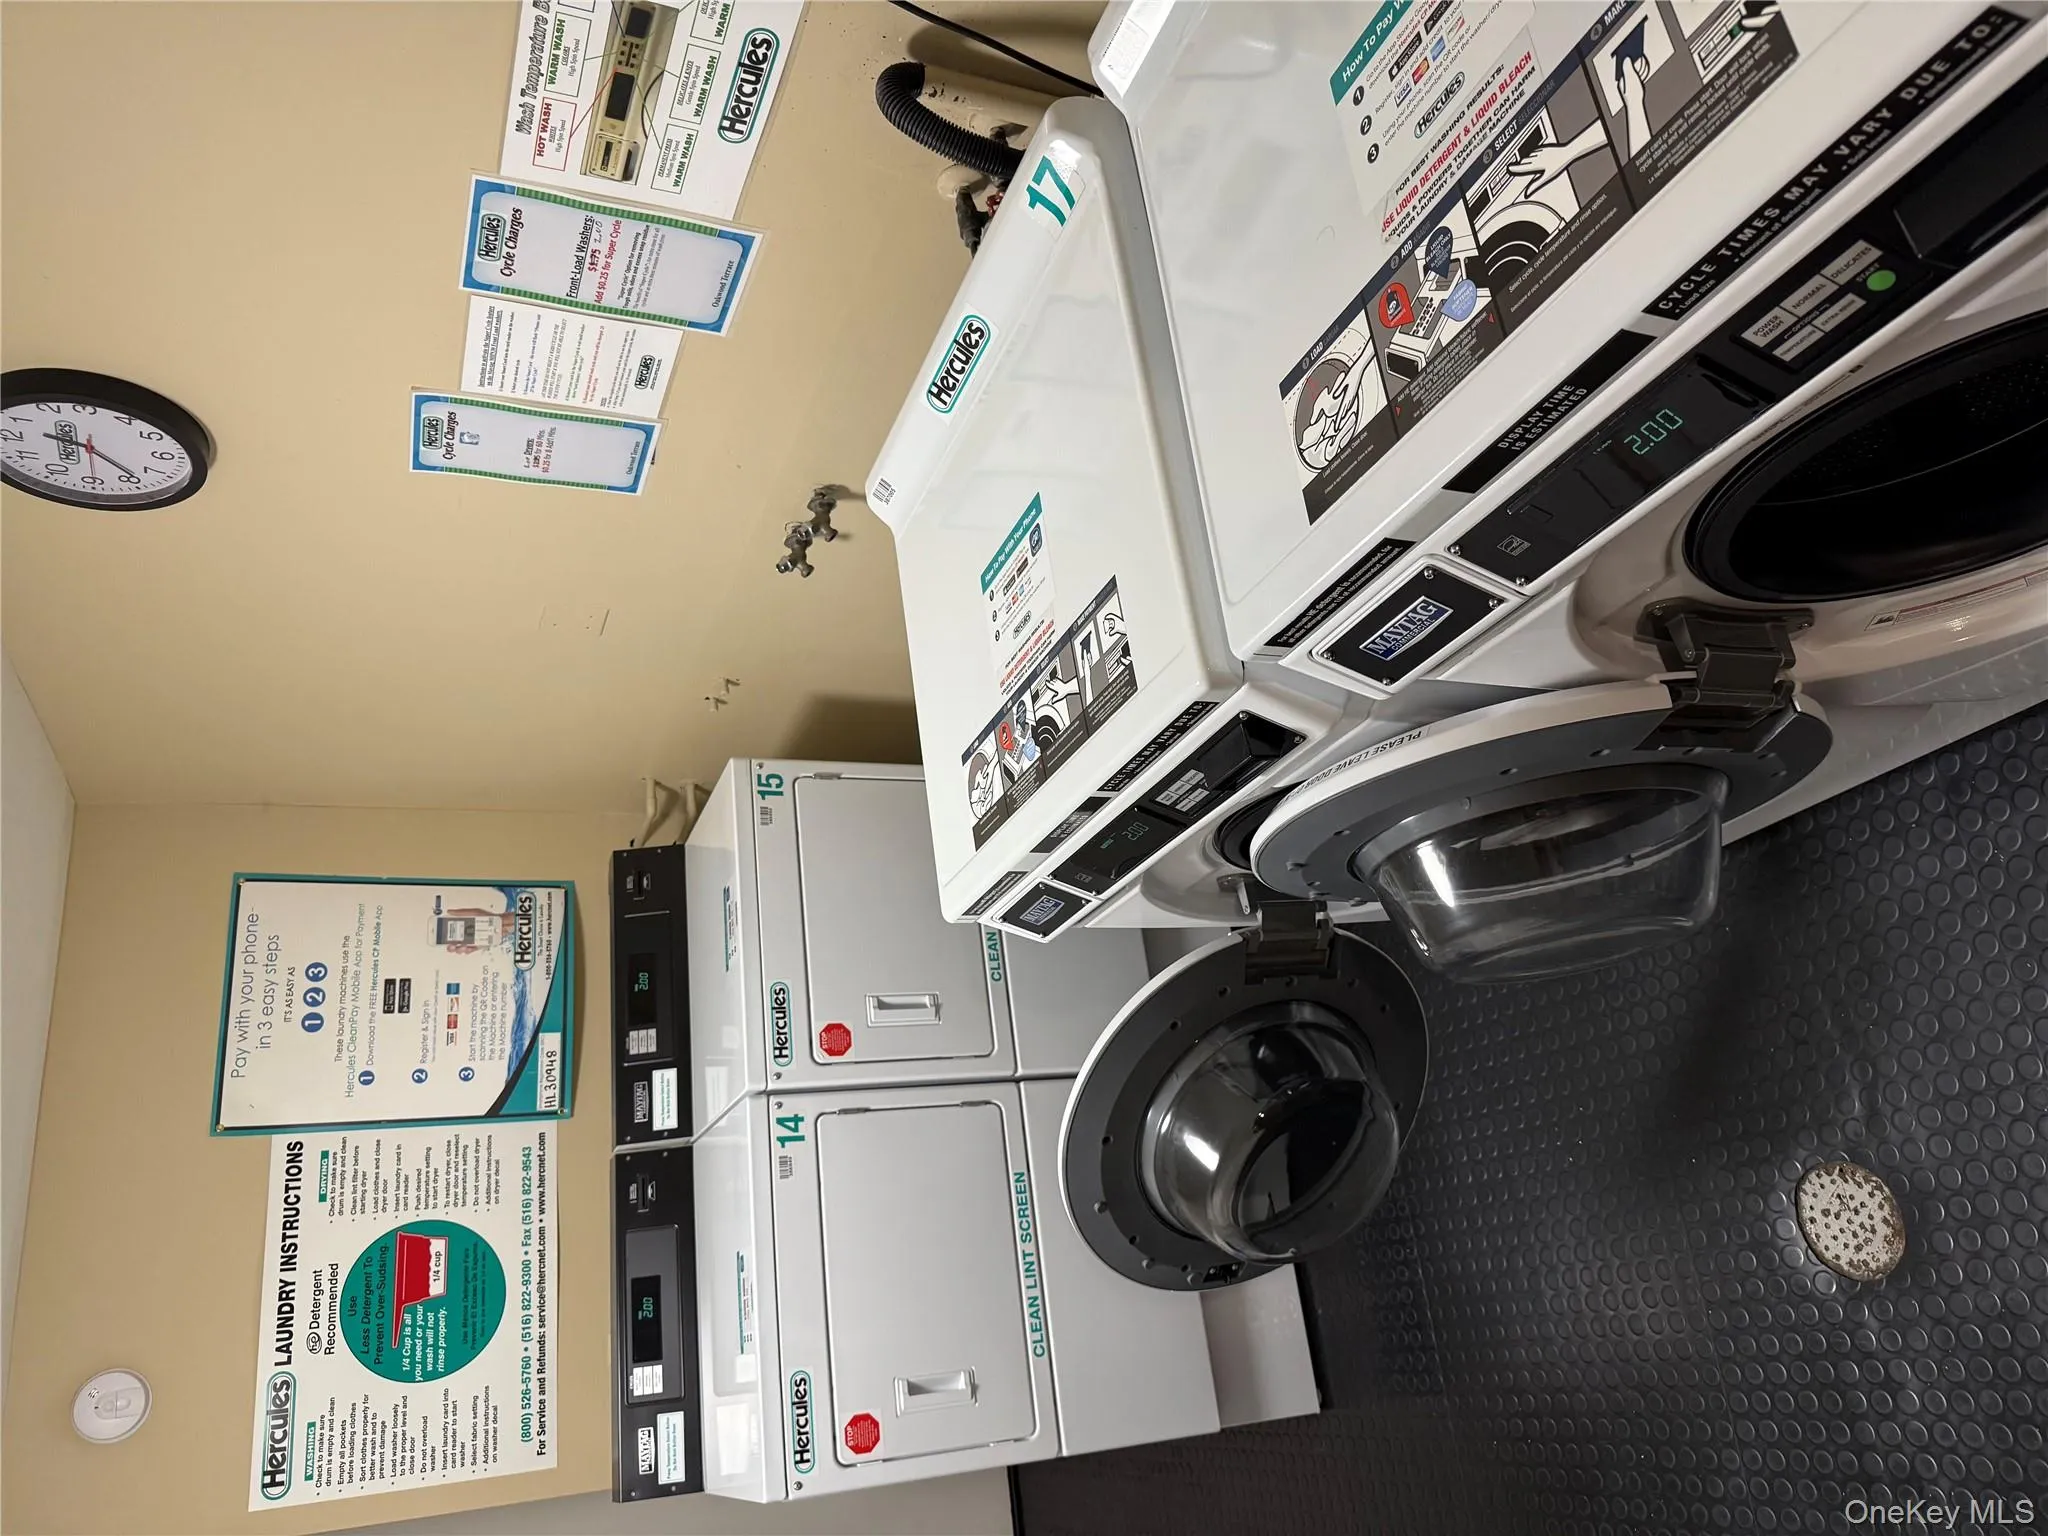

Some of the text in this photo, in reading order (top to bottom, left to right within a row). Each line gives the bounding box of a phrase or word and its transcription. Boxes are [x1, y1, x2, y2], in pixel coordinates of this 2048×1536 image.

[715, 4, 731, 37] WARM
[520, 15, 548, 99] Temperature
[548, 19, 565, 85] WARM WASH
[1343, 8, 1393, 82] How To Pay
[694, 56, 717, 117] WARM WASH
[720, 36, 773, 135] Hercules
[1415, 77, 1463, 134] Hercules
[515, 102, 535, 135] Wash
[537, 103, 552, 156] HOT WASH
[1395, 64, 1504, 195] FOR BEST WASHING RESULTS:
[1395, 185, 1419, 216] LIQUID
[1419, 132, 1462, 188] DETERGENT
[1463, 125, 1470, 136] &
[1471, 92, 1497, 127] LIQUID
[1498, 51, 1531, 94] BLEACH
[1494, 120, 1517, 150] SELECT
[673, 134, 693, 187] WARM WASH
[1659, 15, 2002, 309] CYCLE TIMES MAY VARY DUE TO:
[1026, 155, 1076, 227] 17
[480, 217, 500, 257] Hercules
[504, 207, 524, 249] Charges
[500, 252, 516, 276] Cycle
[566, 215, 593, 297] Front-Load Washers:
[595, 220, 621, 304] Add $0.25 for Super Cycle
[1400, 240, 1413, 258] ADD
[1792, 284, 1826, 309] NORMAL
[1753, 315, 1778, 336] POWER
[927, 321, 987, 405] Hercules
[1310, 341, 1324, 360] LOAD
[36, 403, 61, 414] 2
[73, 404, 96, 415] 3
[114, 415, 136, 425] 4
[1498, 385, 1575, 447] DISPLAY TIME
[1511, 389, 1587, 450] IS ESTIMATED
[1, 430, 23, 442] 12
[140, 431, 163, 440] 5
[424, 418, 439, 446] Hercules
[443, 412, 458, 460] Cycle Charges
[1624, 409, 1683, 454] 2.00
[16, 450, 39, 460] 11
[45, 464, 69, 475] 10
[145, 466, 165, 474] 7
[152, 451, 174, 460] 6
[81, 477, 104, 485] 9
[118, 475, 141, 484] 8
[1366, 603, 1437, 654] MAYTAG
[1392, 618, 1435, 650] COMMERCIAL
[757, 773, 783, 800] 15
[517, 896, 532, 964] Hercules
[987, 932, 1001, 981] CLEAN
[239, 968, 255, 1005] your
[256, 935, 281, 1049] in 3 easy steps
[234, 1009, 250, 1044] with
[773, 987, 788, 1058] Hercules
[231, 1047, 249, 1078] Pay
[636, 1084, 644, 1119] MAYTAG
[777, 1114, 804, 1148] 14
[320, 1159, 328, 1194] DRYING
[434, 1251, 442, 1267] cup
[1014, 1172, 1045, 1357] CLEAN LINT SCREEN
[310, 1270, 323, 1329] Detergent
[325, 1263, 339, 1355] Recommended
[348, 1296, 357, 1316] Use
[360, 1257, 373, 1354] Less Detergent To
[374, 1243, 388, 1364] Prevent Over-Sudsing.
[521, 1146, 533, 1442] (800) 526-5760 (516) 822-9300 Fax (516) 822-9543
[537, 1132, 546, 1456] For Service and Refunds: service@hercnet.com www.hercnet.com
[262, 1141, 303, 1488] Hercules LAUNDRY INSTRUCTIONS
[404, 1313, 412, 1325] all
[404, 1327, 411, 1335] is
[416, 1304, 424, 1325] your
[416, 1327, 422, 1336] or
[403, 1337, 412, 1356] Cup
[426, 1329, 434, 1343] will
[437, 1307, 447, 1371] rinse properly.
[415, 1364, 423, 1381] you
[792, 1377, 811, 1464] Hercules
[306, 1427, 314, 1476] WASHING
[640, 1429, 650, 1471] MAYTAG
